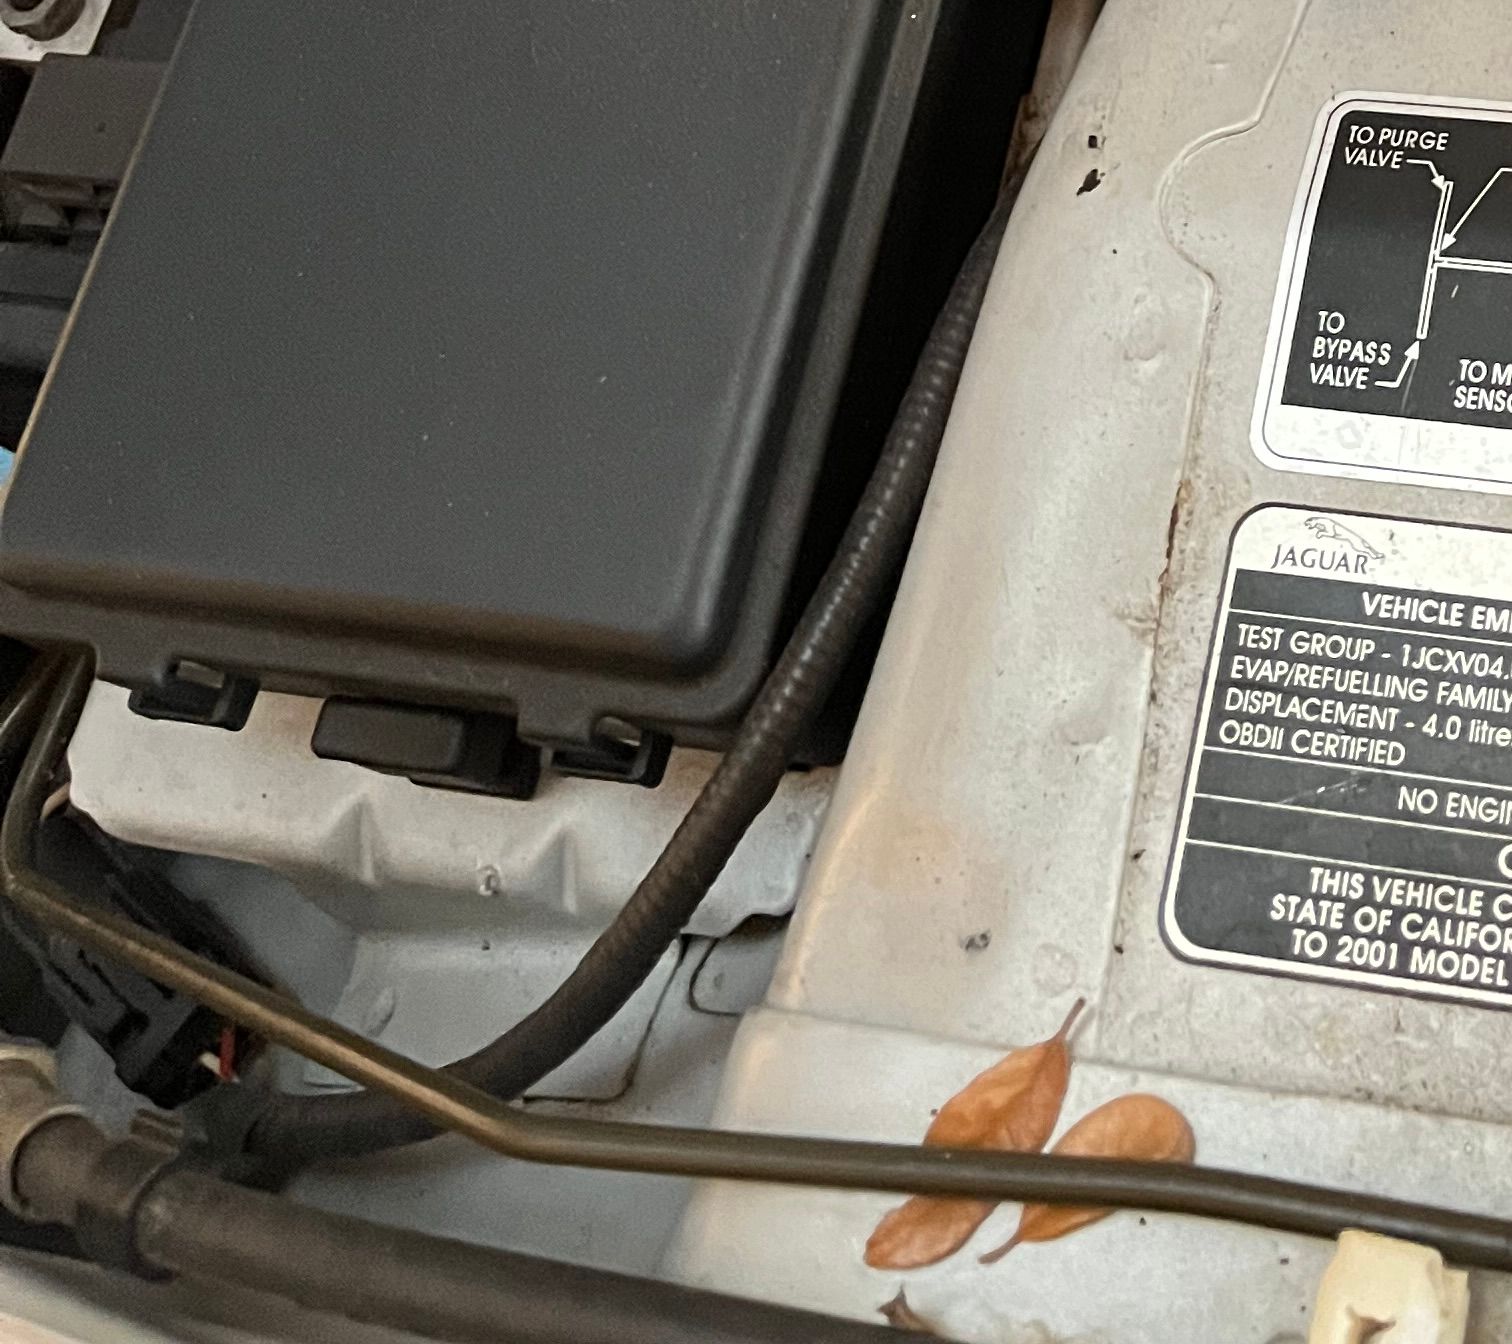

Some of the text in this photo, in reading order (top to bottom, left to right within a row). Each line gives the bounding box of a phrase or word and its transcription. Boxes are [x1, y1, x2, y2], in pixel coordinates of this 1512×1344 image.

[1349, 125, 1449, 150] TO PURGE
[1345, 146, 1403, 168] VALVE
[1318, 310, 1345, 333] TO
[1312, 336, 1391, 365] BYPASS
[1310, 362, 1369, 389] VALVE
[1459, 359, 1487, 383] TO
[1270, 544, 1369, 574] JAGUAR
[1362, 591, 1465, 627] VEHICLE
[1238, 623, 1284, 650] TEST
[1289, 630, 1375, 661] GROUP
[1230, 655, 1428, 702] EVAP/REFUELLING
[1224, 687, 1400, 731] DISPLACEMENT
[1422, 713, 1461, 740] 4.0
[1219, 719, 1405, 766] OBDII CERTIFIED
[1398, 786, 1437, 814] NO
[1310, 867, 1364, 899] THIS
[1372, 876, 1484, 917] VEHICLE
[1270, 893, 1345, 929] STATE
[1353, 906, 1393, 935] OF
[1292, 928, 1327, 958] TO
[1335, 935, 1397, 969] 2001
[1409, 946, 1508, 986] MODEL
